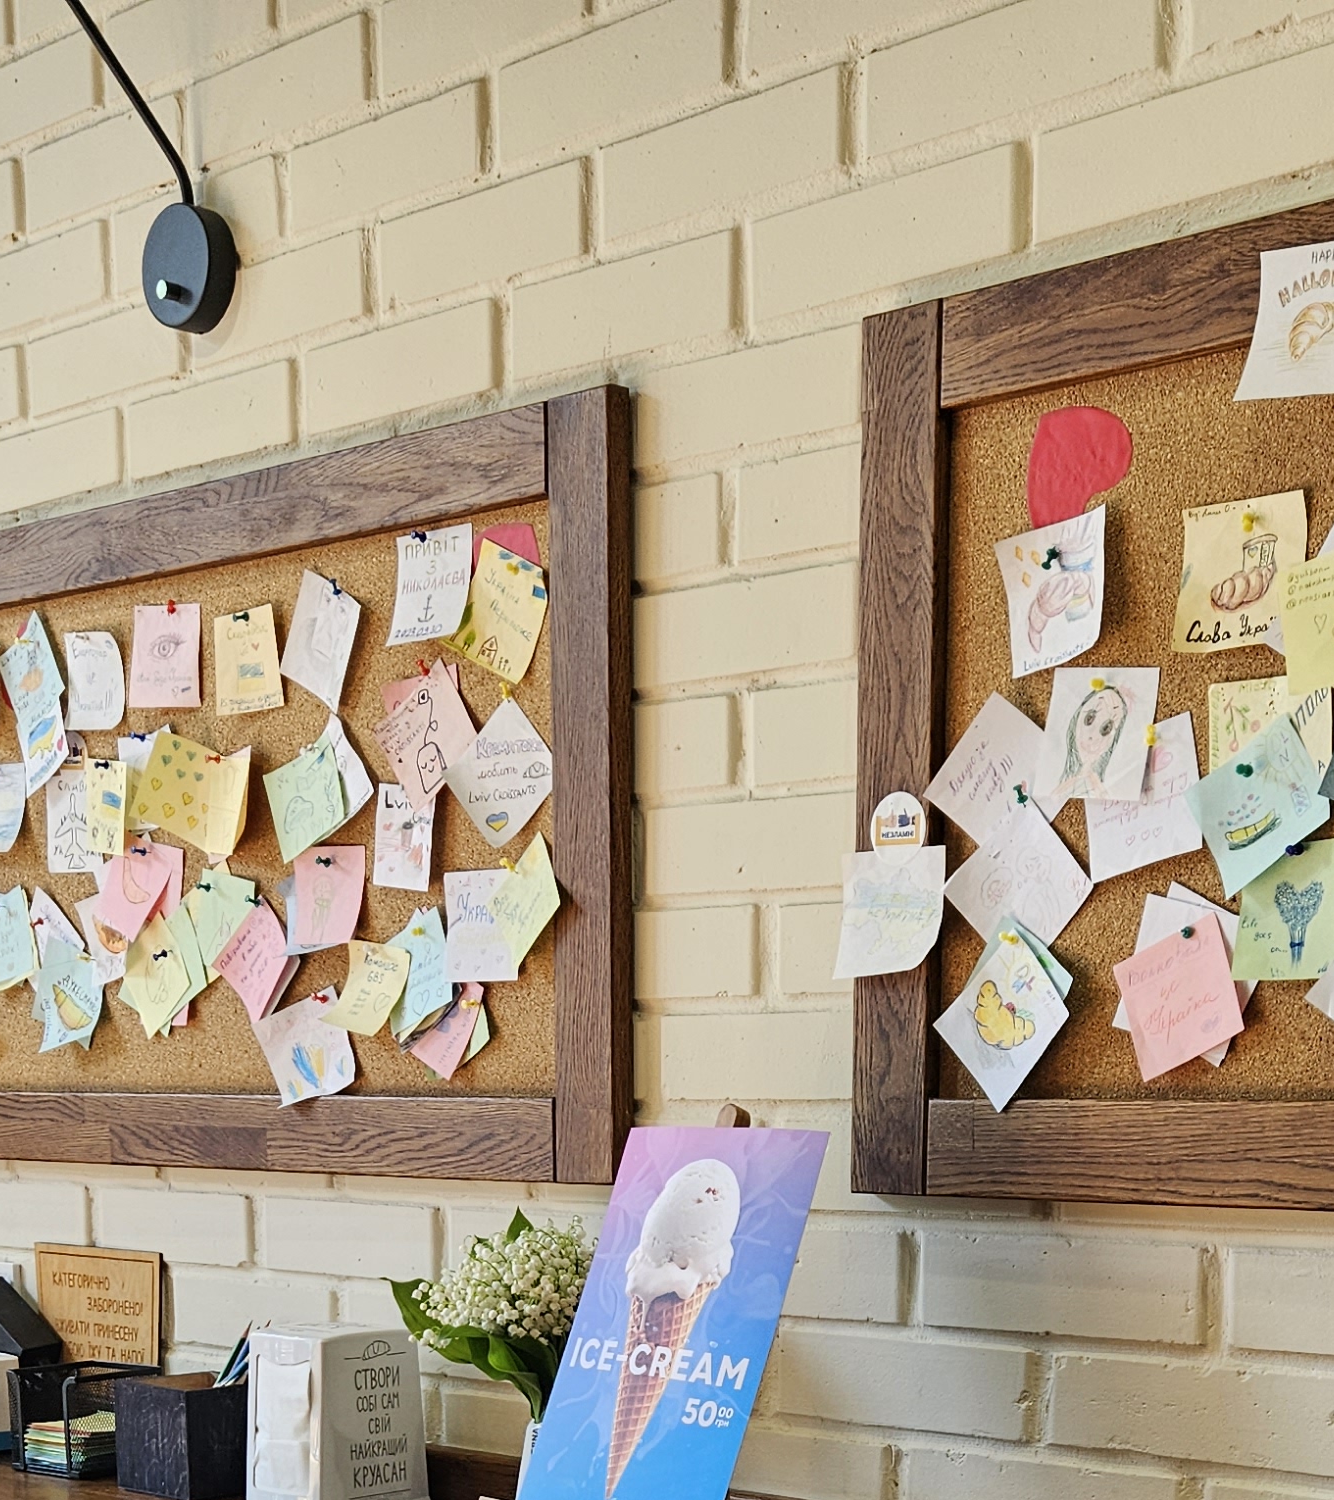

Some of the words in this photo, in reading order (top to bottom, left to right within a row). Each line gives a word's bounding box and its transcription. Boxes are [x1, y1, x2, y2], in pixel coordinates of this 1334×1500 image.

[404, 535, 460, 561] ПРИВІТ
[1185, 619, 1232, 644] Слава
[1238, 613, 1277, 639] Укра
[51, 1270, 111, 1292] КАТЕГОРИЧНО
[86, 1296, 145, 1317] ЗАБОРОНЕНО!
[93, 1322, 140, 1343] ПРИНЕСЕНУ
[105, 1348, 116, 1360] ТА
[569, 1337, 750, 1390] ICE-CREAM
[354, 1364, 401, 1392] СТВОРИ
[356, 1394, 377, 1413] СОБІ
[381, 1391, 400, 1410] САМ
[680, 1398, 717, 1427] 50
[368, 1413, 392, 1435] СВІЙ
[714, 1418, 729, 1429] грн
[349, 1433, 409, 1462] НАЙКРАЩИЙ
[353, 1460, 408, 1490] КРУАСАН
